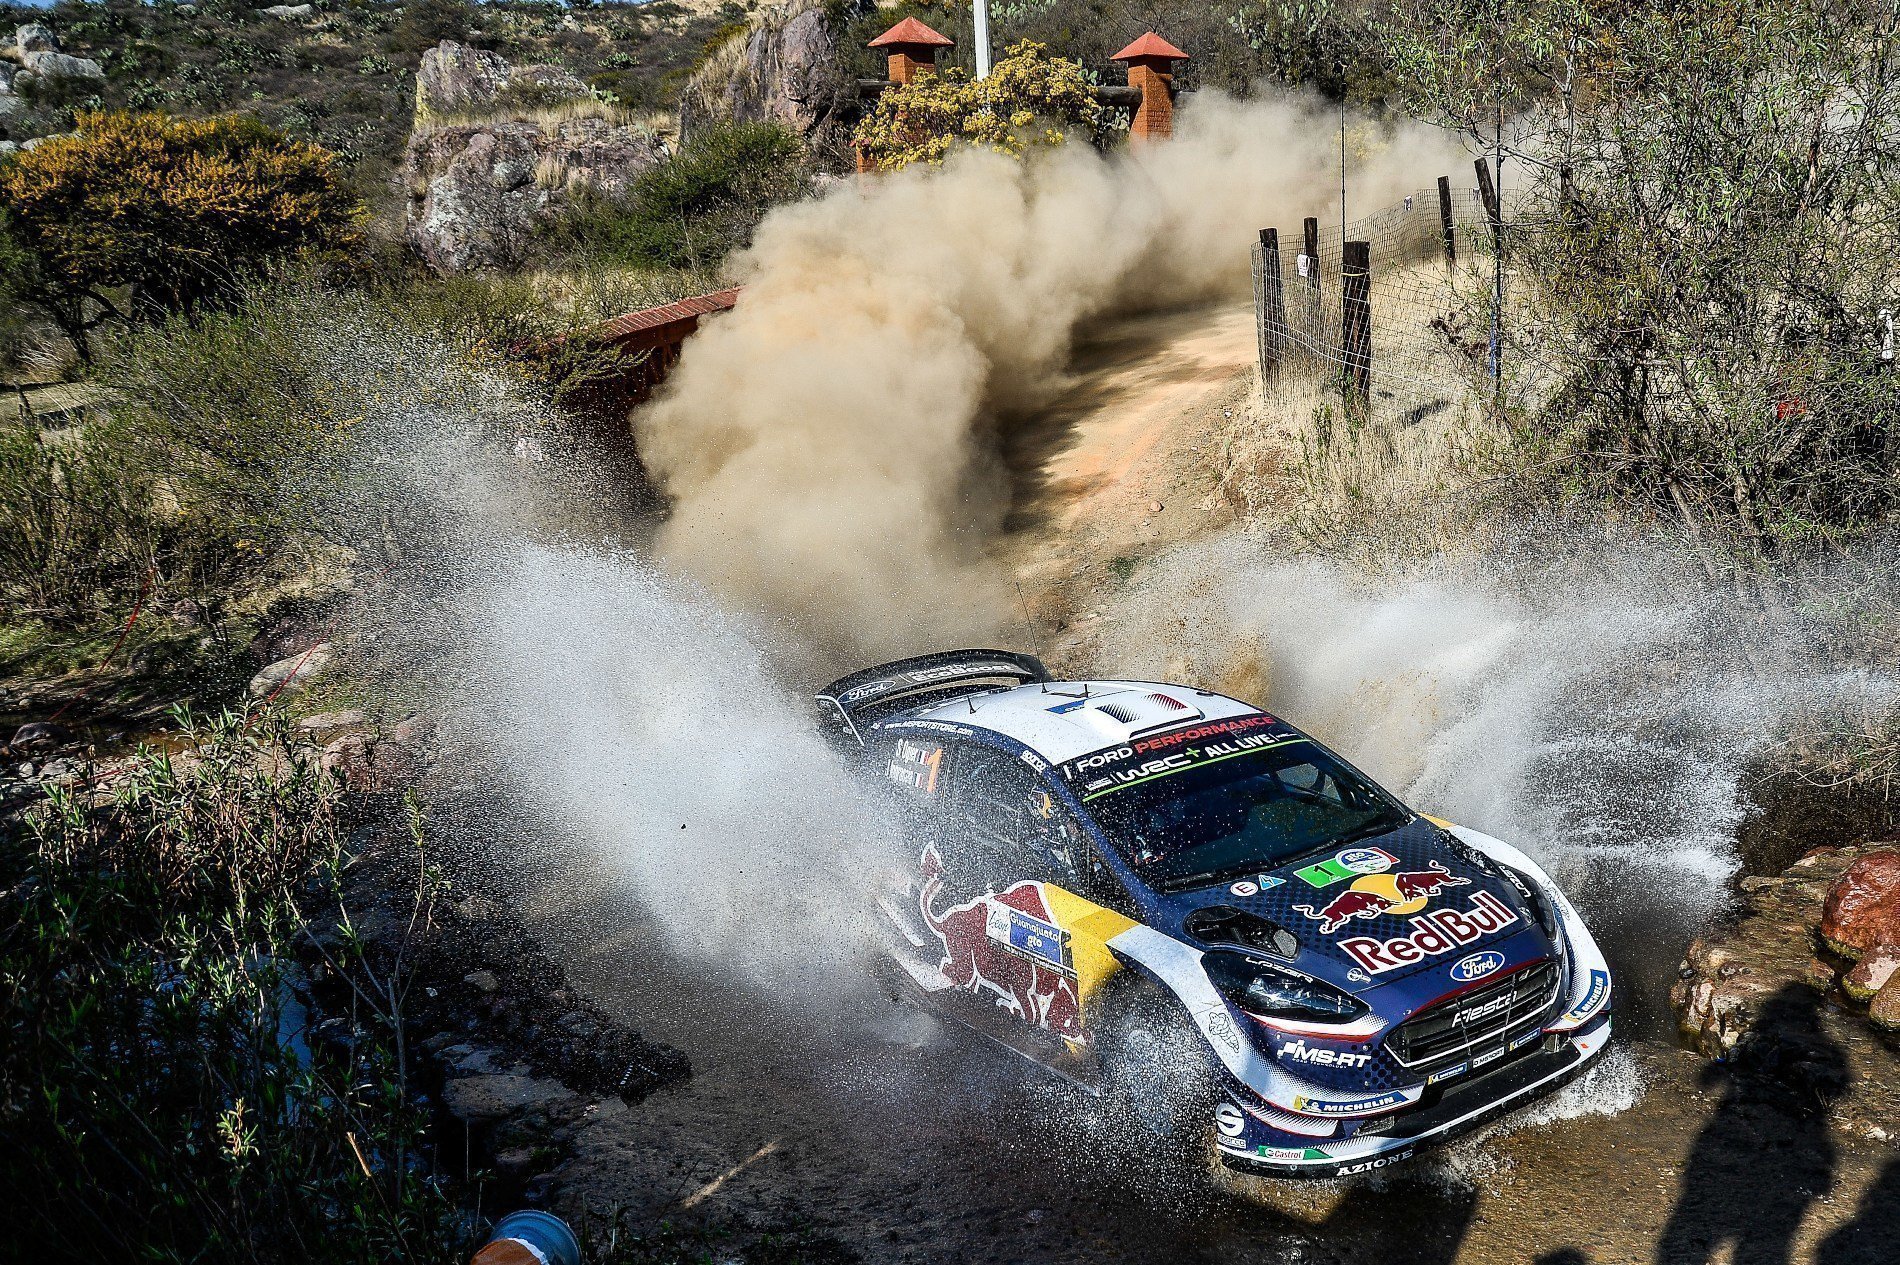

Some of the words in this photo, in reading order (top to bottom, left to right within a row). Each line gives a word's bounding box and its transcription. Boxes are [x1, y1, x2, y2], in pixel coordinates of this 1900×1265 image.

[848, 684, 887, 701] Ford
[1078, 747, 1133, 773] FORD
[1135, 716, 1276, 754] PERFORMANCE
[1205, 743, 1239, 758] ALL
[1241, 733, 1276, 749] LIVE
[926, 748, 943, 793] 1
[1023, 750, 1047, 771] sparco
[1313, 864, 1335, 877] 1
[1236, 883, 1251, 894] E
[1010, 912, 1059, 941] Guanajuato
[1338, 918, 1451, 974] Red
[1432, 891, 1517, 945] Bull
[1027, 935, 1042, 948] gto
[1461, 955, 1498, 979] Ford
[1581, 976, 1604, 1012] MICHELIN
[1452, 991, 1518, 1027] Fiesta
[1323, 1096, 1395, 1112] MICHELIN
[1274, 1149, 1302, 1159] Castrol
[1336, 1149, 1414, 1177] AZIONE
